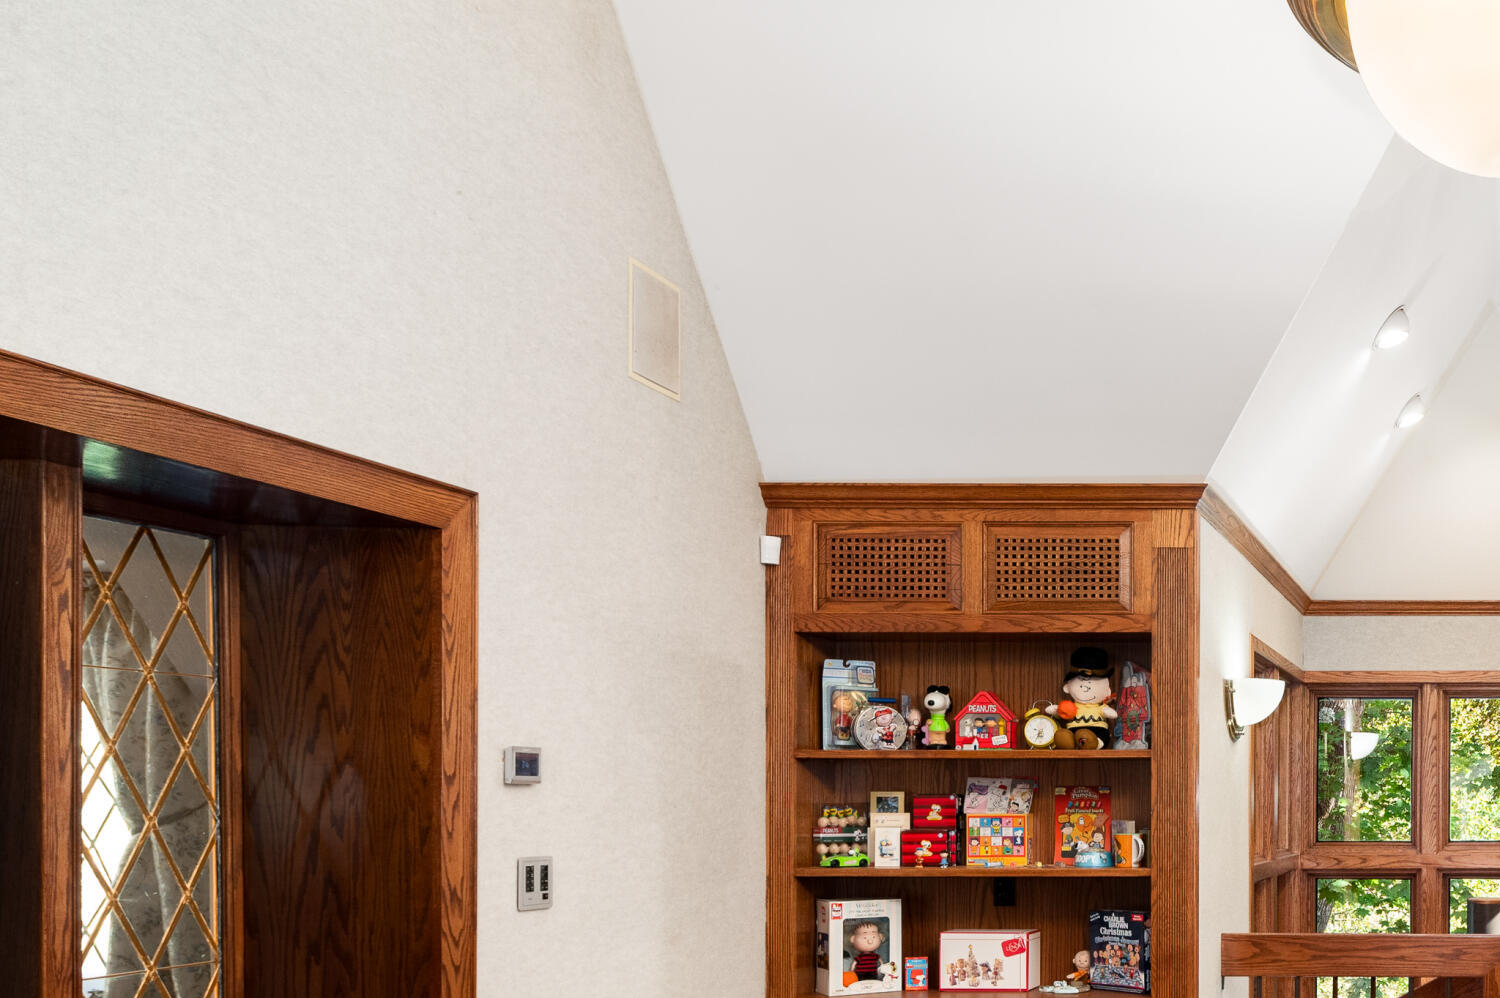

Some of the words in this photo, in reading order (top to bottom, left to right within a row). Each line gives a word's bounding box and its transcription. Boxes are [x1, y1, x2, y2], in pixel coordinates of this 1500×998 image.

[968, 704, 997, 713] PEANUTS
[1108, 922, 1129, 930] BROWN
[1100, 927, 1132, 937] Christmas
